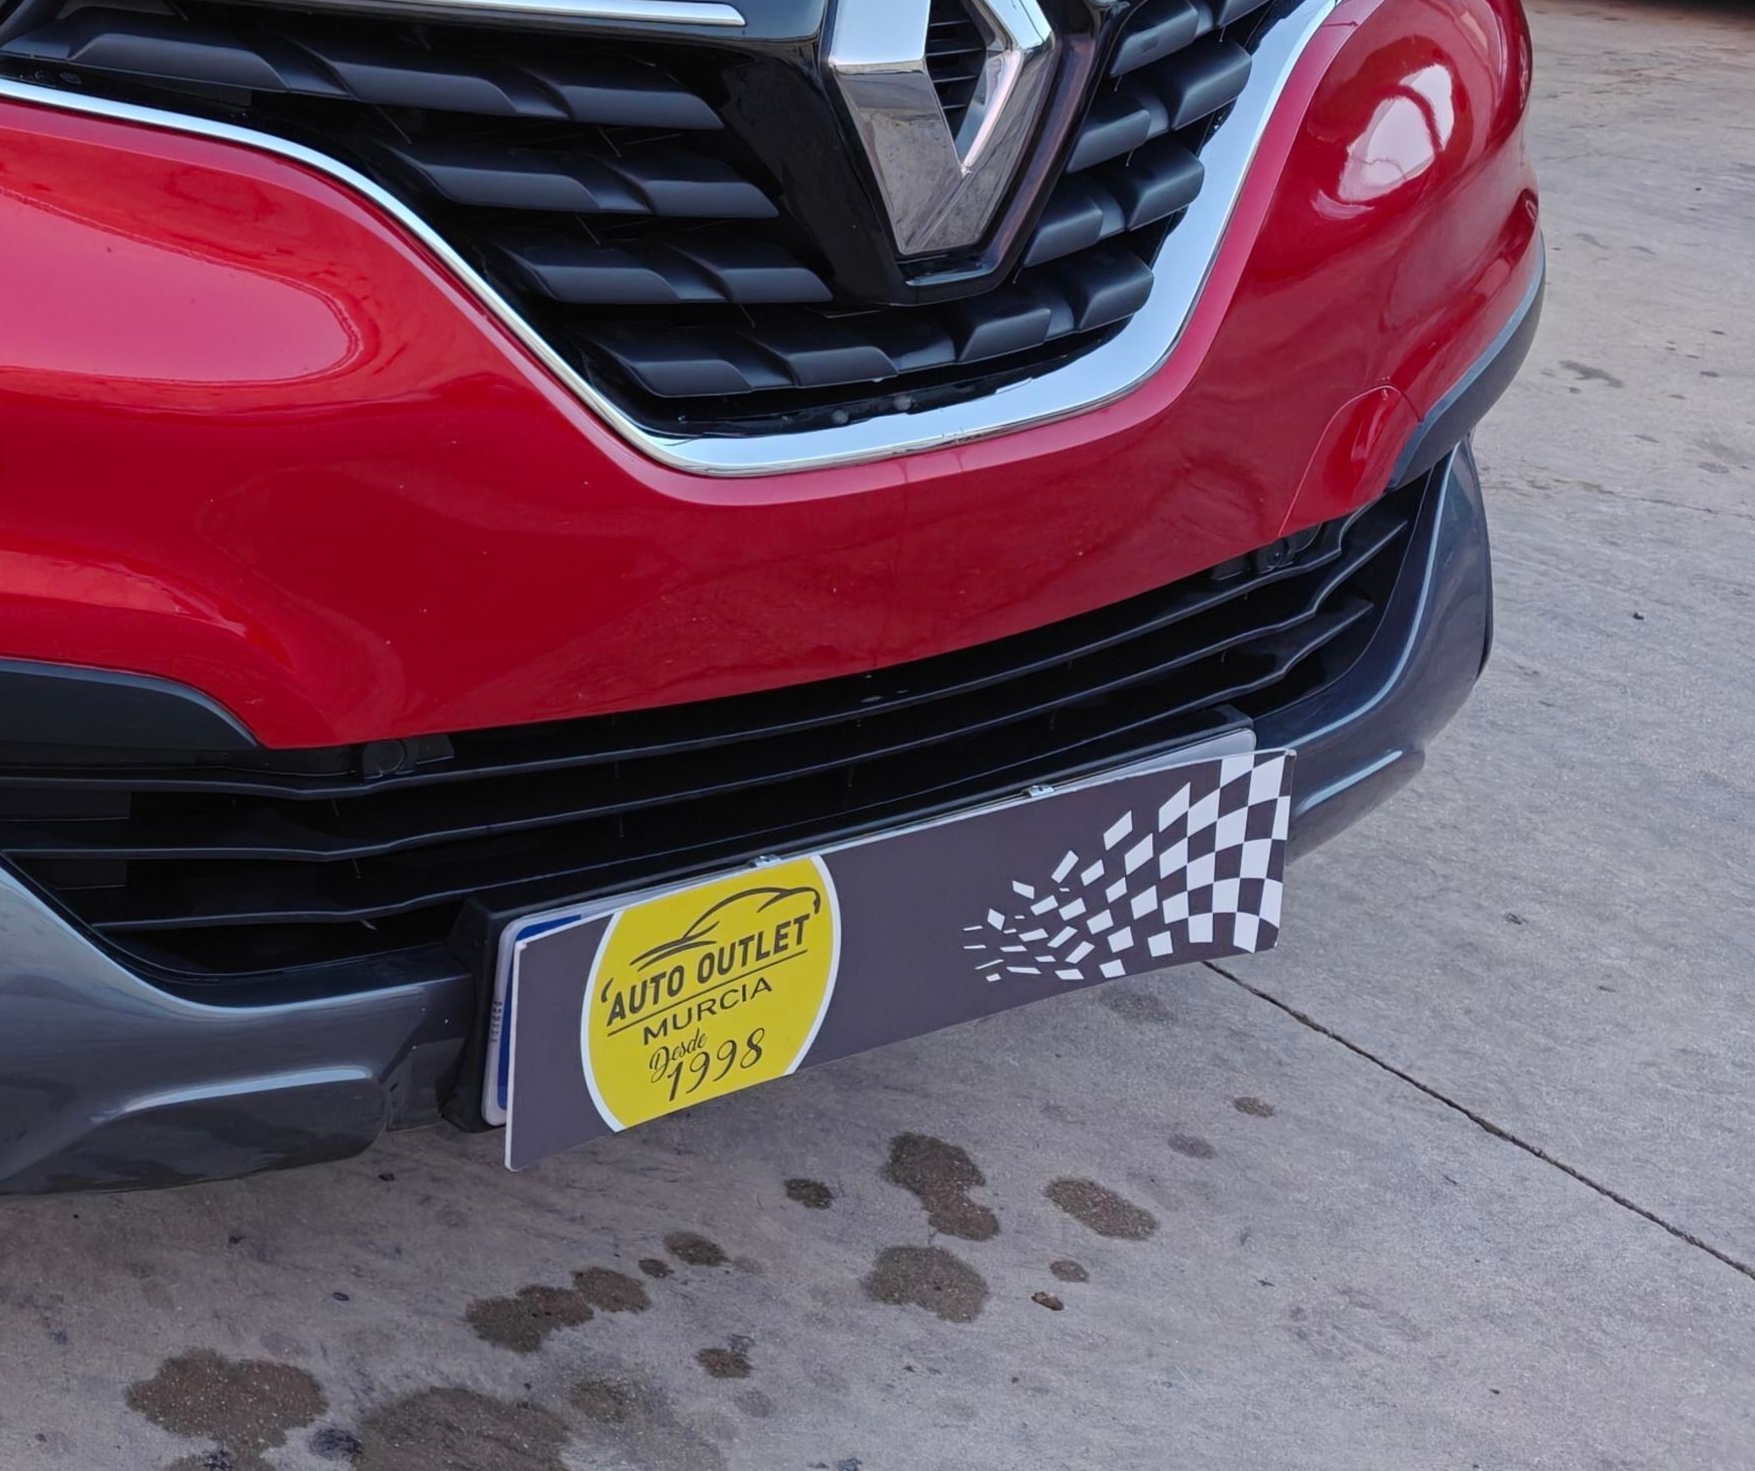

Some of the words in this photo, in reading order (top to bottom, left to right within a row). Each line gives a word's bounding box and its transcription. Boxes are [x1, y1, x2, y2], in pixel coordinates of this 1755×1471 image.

[606, 965, 685, 1027] AUTO
[697, 912, 811, 984] OUTLET
[643, 977, 773, 1046] MURCIA
[649, 1028, 708, 1084] Desde
[667, 1027, 766, 1102] 1998
